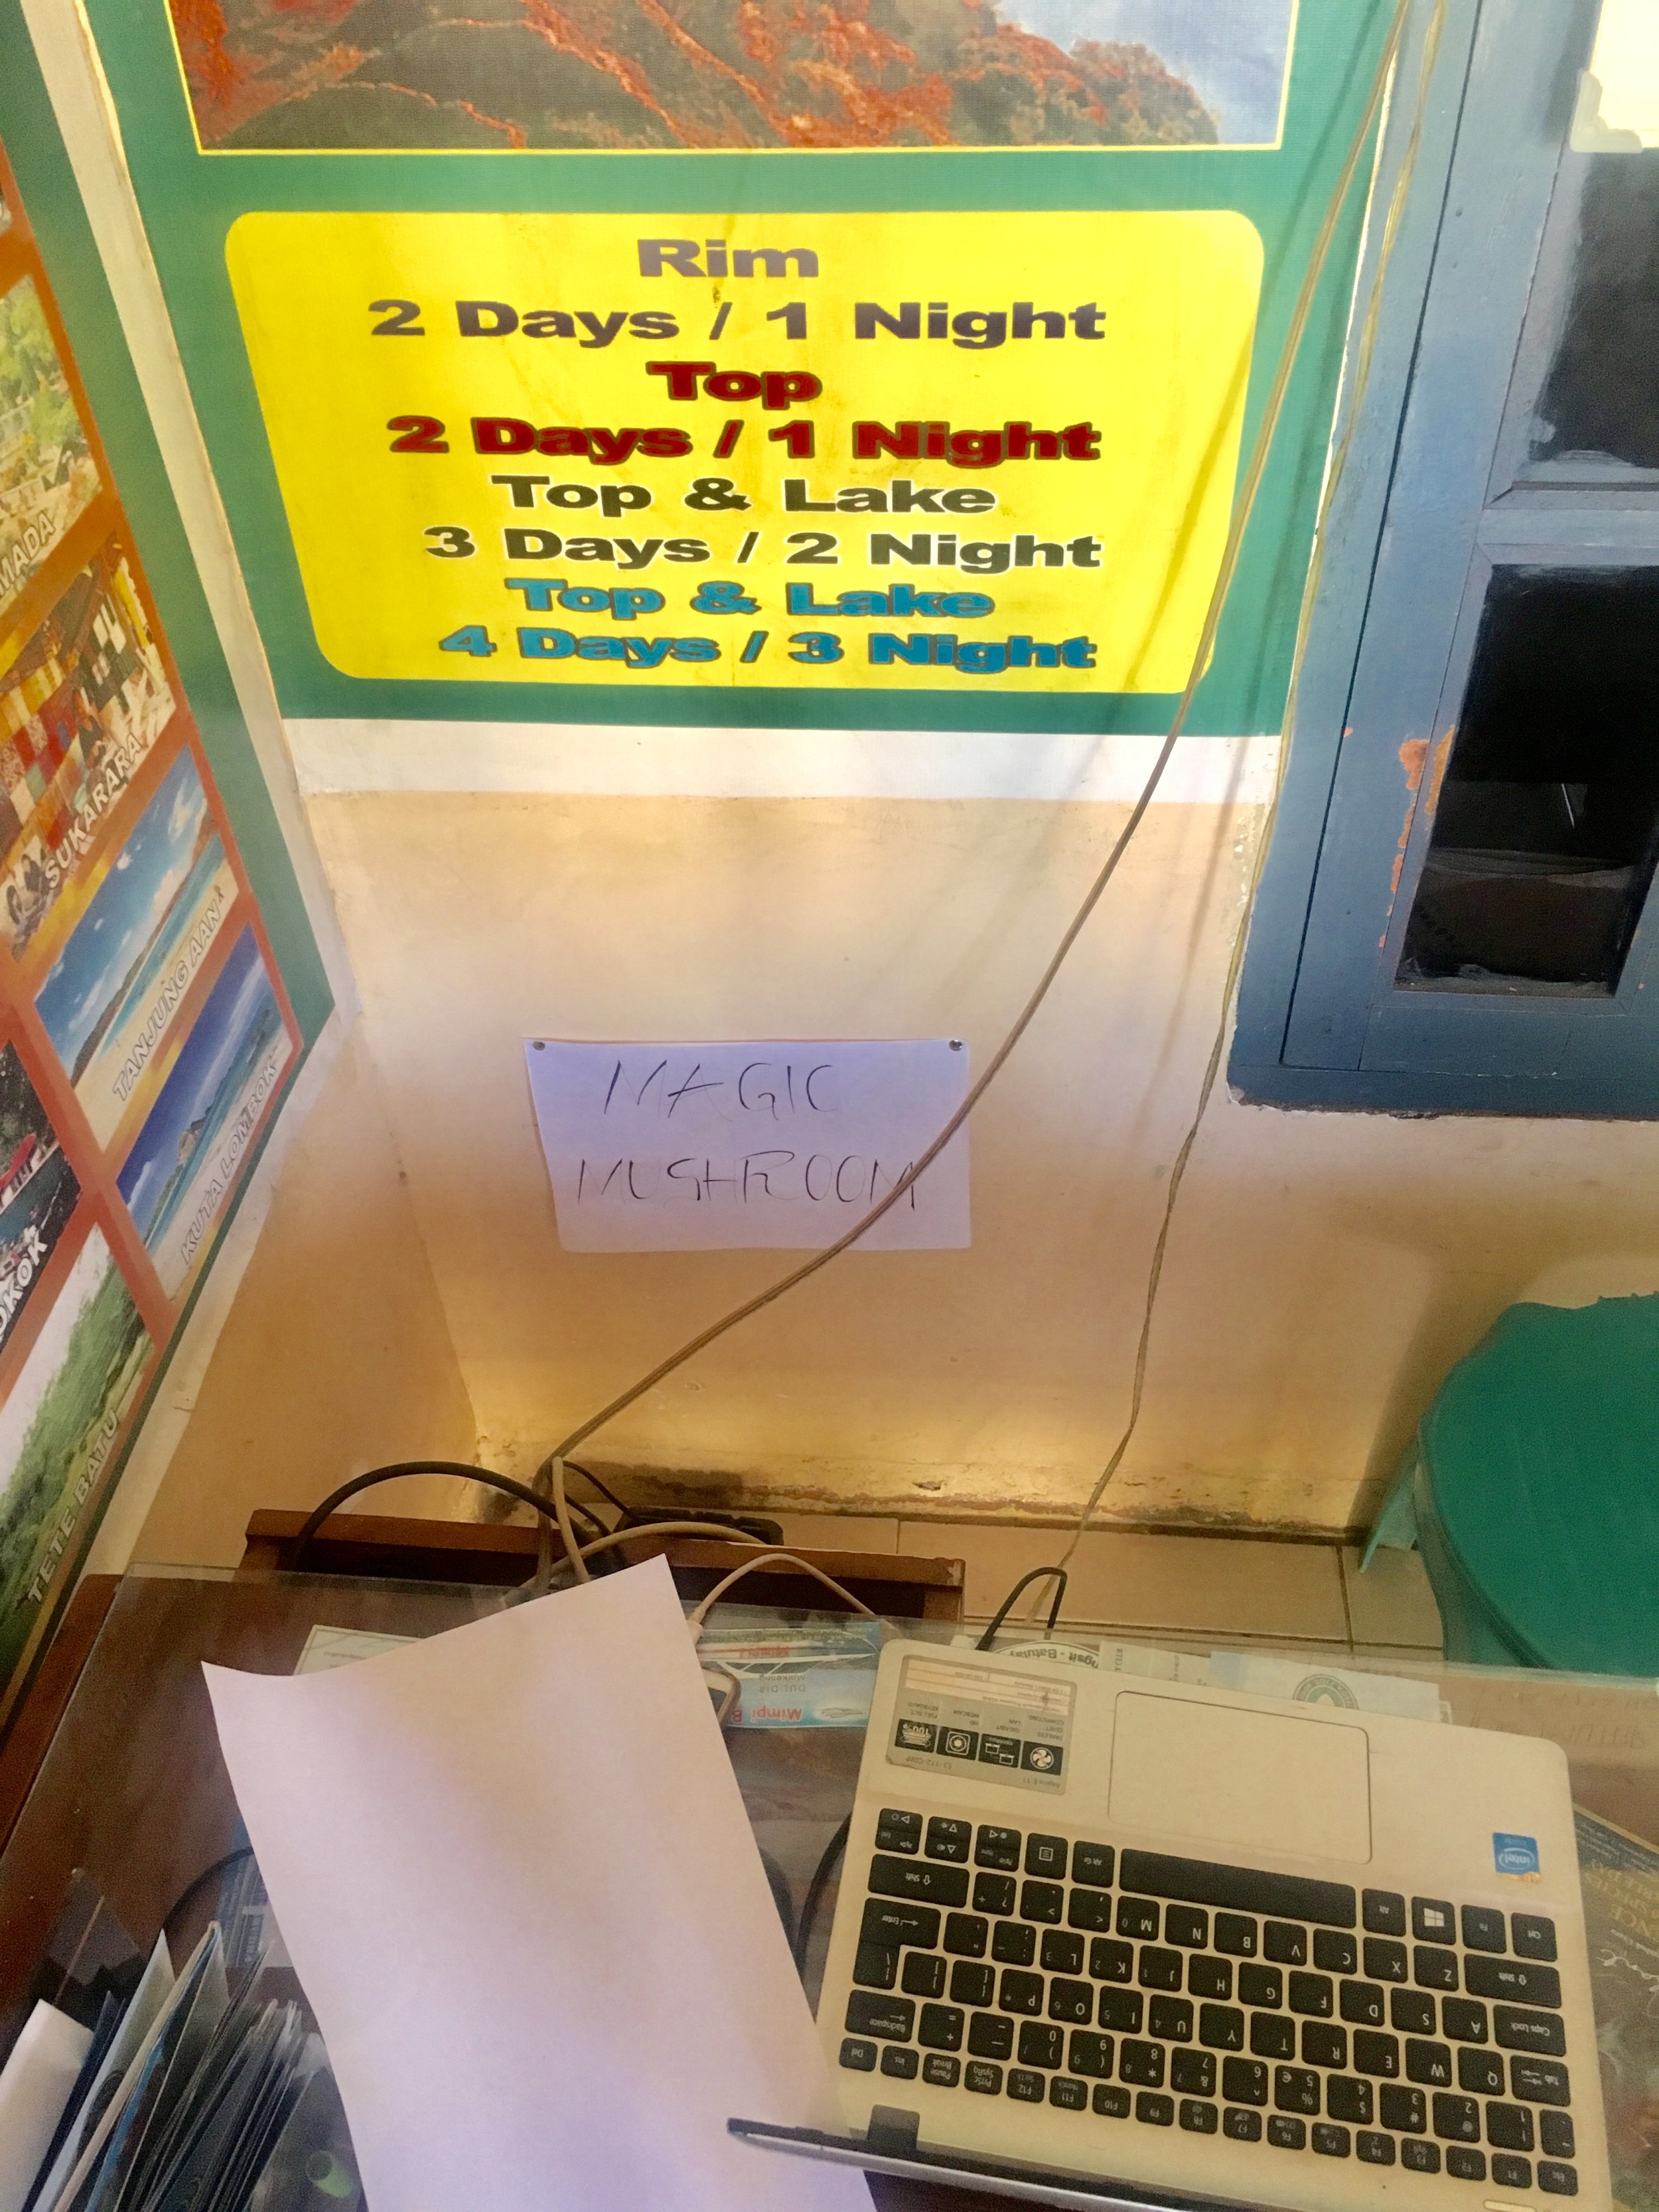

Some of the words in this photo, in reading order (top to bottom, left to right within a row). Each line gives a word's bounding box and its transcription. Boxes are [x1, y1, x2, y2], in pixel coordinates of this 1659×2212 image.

[637, 239, 819, 277] Rim
[368, 299, 425, 336] 2
[455, 300, 680, 348] Days
[709, 302, 733, 340] /
[766, 302, 807, 340] 1
[855, 302, 1107, 350] Night
[645, 360, 823, 411] Top
[386, 415, 450, 455] 2
[470, 416, 695, 467] Days
[716, 419, 745, 459] /
[768, 420, 815, 459] 1
[852, 421, 1102, 469] Night
[491, 475, 652, 518] Top
[684, 477, 753, 512] &
[784, 479, 996, 514] Lake
[423, 526, 476, 558] 3
[503, 528, 711, 570] Days
[737, 532, 760, 563] /
[786, 532, 838, 564] 2
[871, 534, 1102, 575] Night
[504, 577, 666, 621] Top
[689, 580, 762, 615] &
[786, 582, 995, 617] Lake
[439, 625, 497, 657] 4
[516, 627, 722, 669] Days
[739, 630, 770, 664] /
[788, 630, 845, 664] 3
[868, 632, 1098, 675] Night
[44, 731, 143, 889] SUKARARA
[112, 959, 189, 1102] TANJUNG
[188, 898, 222, 968] AAN
[604, 1059, 840, 1122] MAGIC
[180, 1179, 224, 1266] KUTA
[220, 1061, 279, 1180] LOMBOK
[28, 1507, 76, 1603] TETE
[74, 1408, 118, 1505] BATU
[758, 1674, 806, 1682] Marketing
[750, 1705, 803, 1724] Mimpi
[953, 1708, 979, 1719] WEBCAM
[1028, 1714, 1064, 1726] COMPUTING
[1093, 1857, 1102, 1866] Alt
[1504, 1853, 1531, 1866] intel
[905, 1872, 920, 1882] Shift
[1379, 1905, 1390, 1915] Alt
[881, 1915, 900, 1923] Enter
[1141, 1919, 1152, 1932] M
[1192, 1927, 1202, 1940] N
[1528, 1929, 1542, 1939] Ctrl
[1243, 1936, 1251, 1949] B
[1291, 1944, 1301, 1957] V
[1070, 1953, 1077, 1966] L
[1342, 1952, 1351, 1965] C
[1117, 1962, 1126, 1974] K
[1392, 1960, 1401, 1974] X
[1444, 1969, 1452, 1982] Z
[1498, 1971, 1515, 1982] Shift
[1216, 1978, 1225, 1992] H
[1028, 1994, 1036, 2006] P
[1266, 1987, 1275, 2000] G
[1320, 1996, 1327, 2009] F
[1368, 2004, 1378, 2017] D
[869, 2018, 906, 2033] Backspace
[1421, 2013, 1429, 2026] S
[1177, 2020, 1186, 2033] U
[1471, 2020, 1481, 2035] A
[1510, 2022, 1528, 2033] Lock
[1530, 2024, 1550, 2037] Caps
[1227, 2029, 1236, 2043] Y
[1100, 2039, 1107, 2051] 9
[1280, 2037, 1288, 2051] T
[1151, 2048, 1158, 2061] 8
[1332, 2047, 1340, 2059] R
[932, 2059, 952, 2070] Break
[1202, 2057, 1208, 2068] 7
[1385, 2055, 1392, 2069] E
[930, 2069, 951, 2080] Pause
[1254, 2065, 1261, 2078] 6
[1431, 2063, 1445, 2078] W
[1306, 2075, 1313, 2087] 5
[1488, 2071, 1498, 2086] Q
[1019, 2085, 1032, 2095] F12
[1358, 2084, 1366, 2095] 4
[1061, 2093, 1074, 2102] F11
[1411, 2093, 1419, 2105] 3
[1104, 2099, 1118, 2110] F10
[1465, 2102, 1472, 2114] 2
[1237, 2123, 1248, 2134] F7
